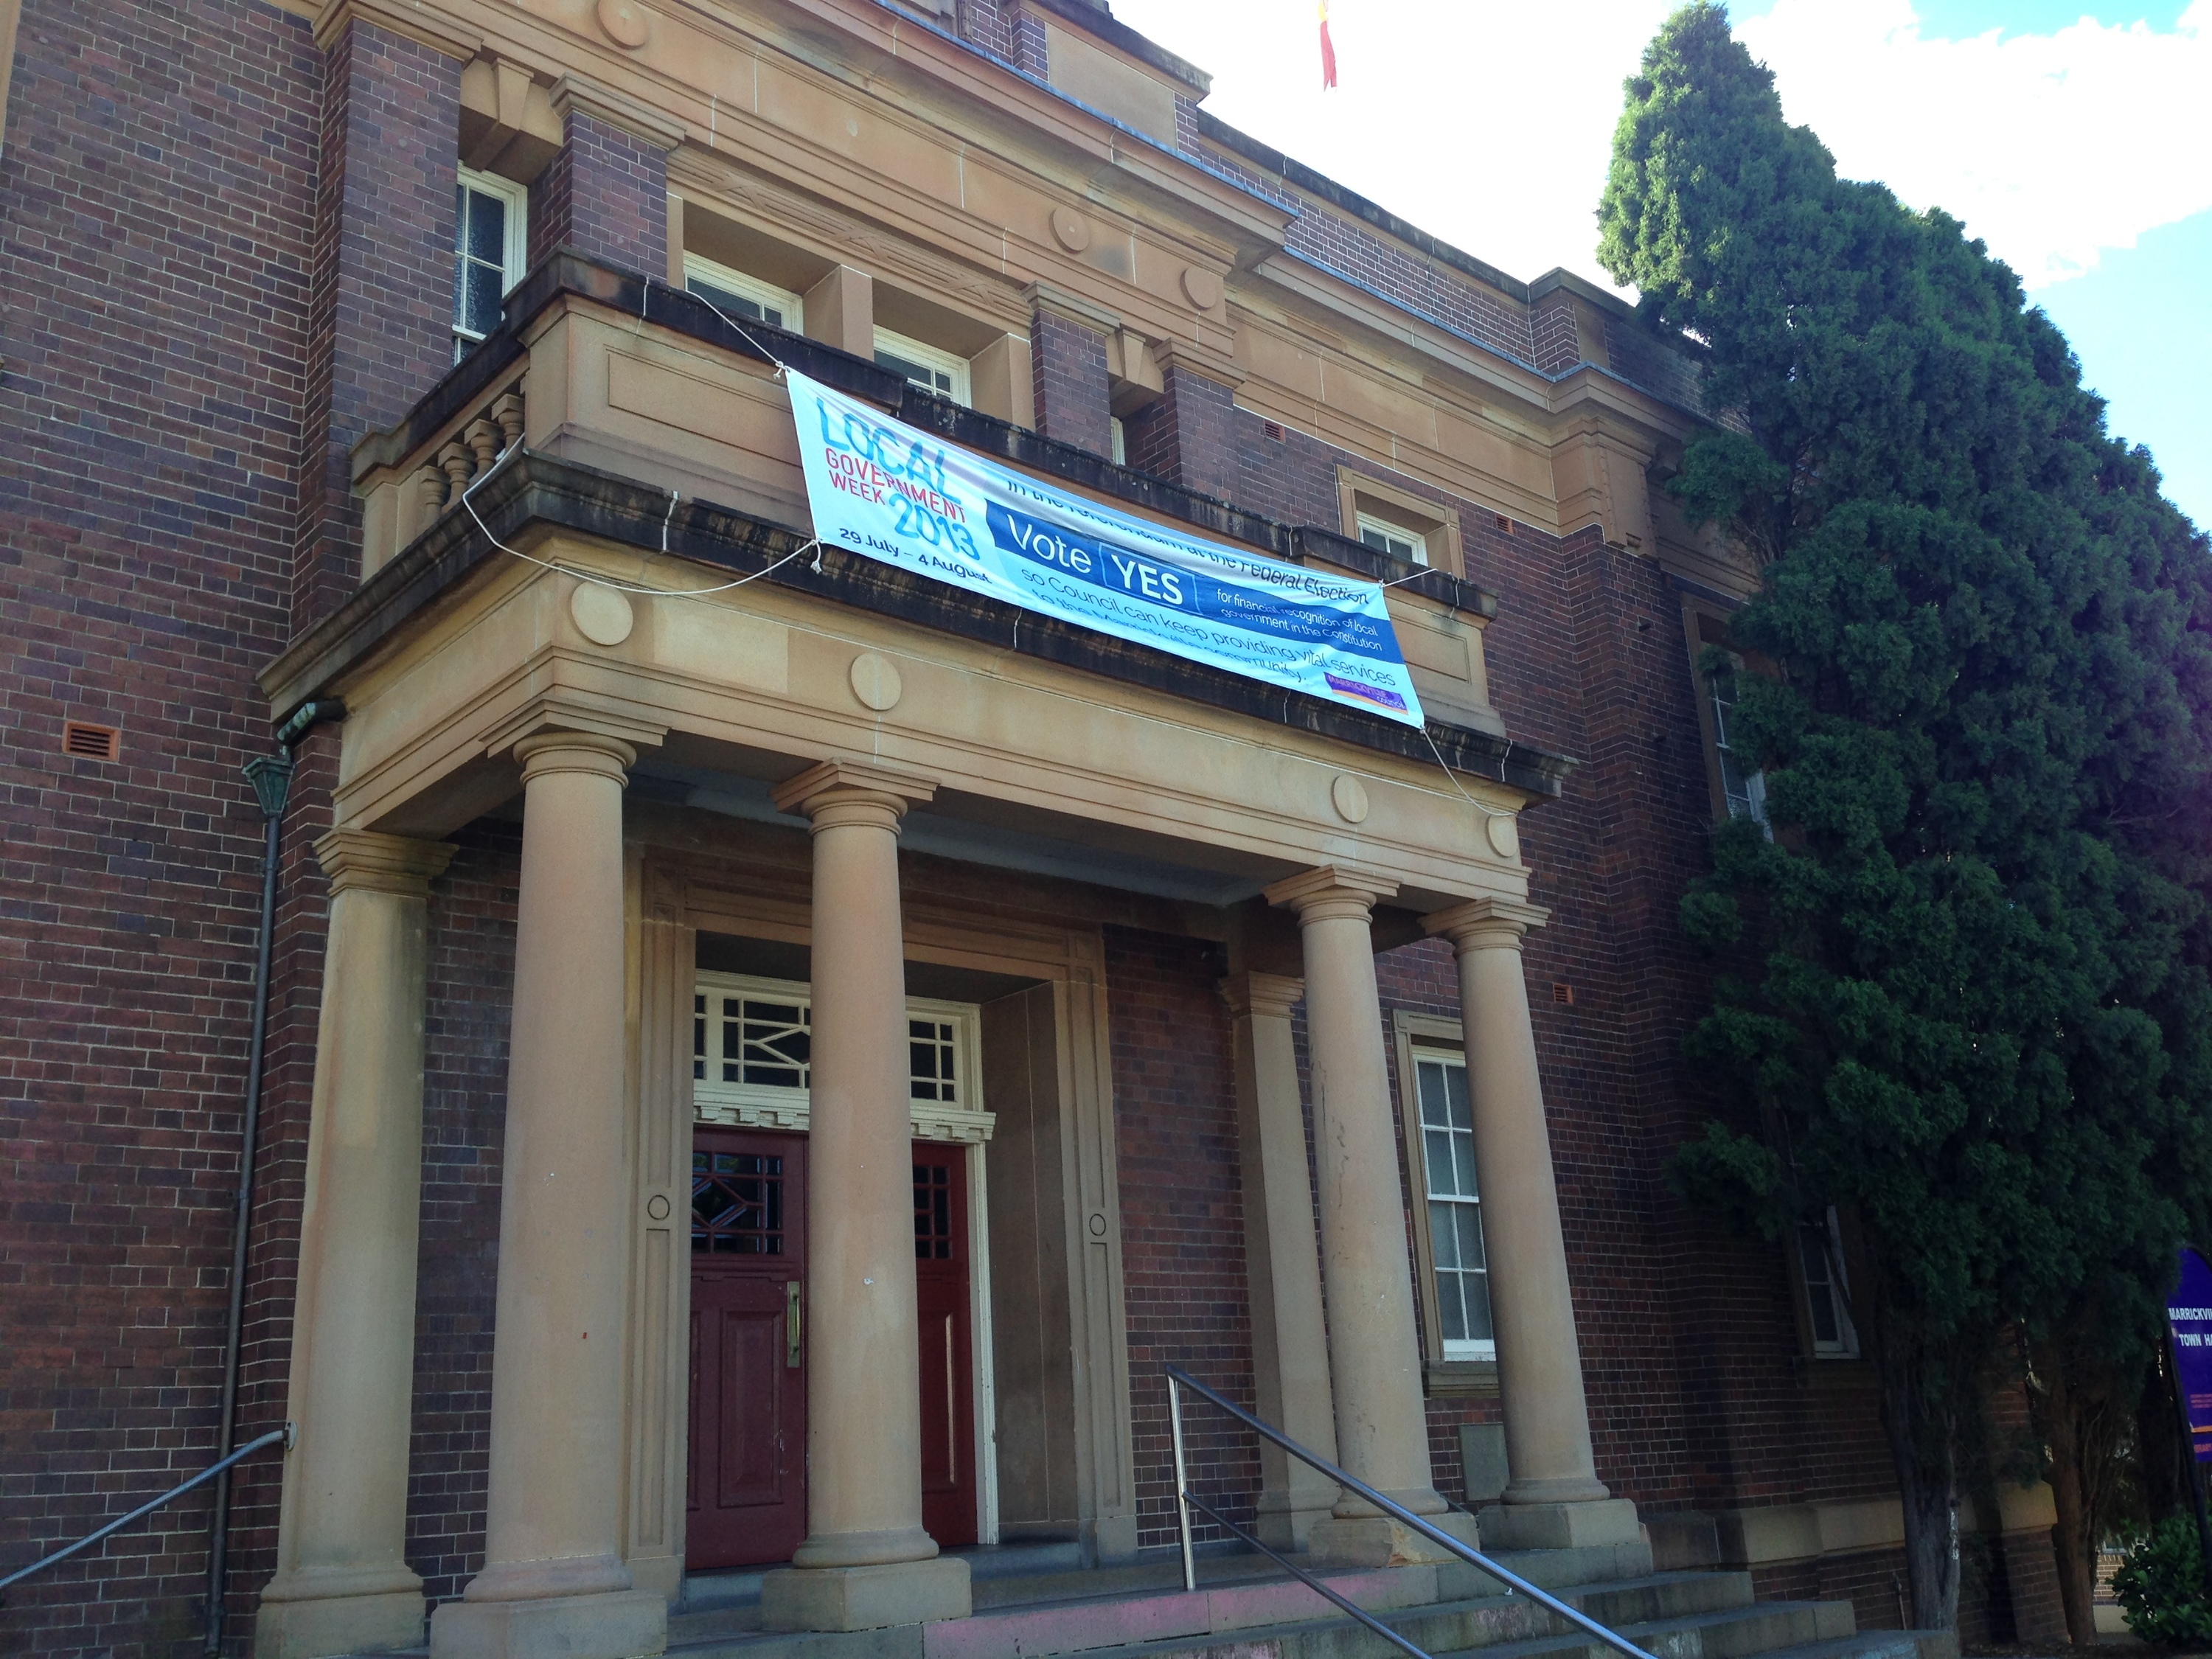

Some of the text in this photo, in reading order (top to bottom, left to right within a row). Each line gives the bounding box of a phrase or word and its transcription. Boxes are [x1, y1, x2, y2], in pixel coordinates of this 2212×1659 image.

[816, 397, 961, 504] LOCAL
[825, 448, 966, 523] GOVERNMENT
[829, 470, 886, 506] WEEK
[888, 493, 981, 561] 2013
[1032, 490, 1064, 509] the
[1207, 550, 1237, 568] the
[1241, 560, 1301, 591] Federal
[1304, 577, 1370, 605] Election
[839, 528, 862, 544] 29
[866, 535, 899, 557] July
[918, 554, 929, 566] 4
[932, 556, 992, 584] August
[1006, 514, 1183, 605] Vote YES
[1021, 568, 1396, 686] so Council can keep providing vital services
[1032, 588, 1054, 605] to
[1056, 597, 1092, 616] the
[1217, 588, 1378, 636] for financial recognition of local
[1220, 608, 1290, 631] government
[1291, 622, 1301, 633] in
[1302, 625, 1321, 636] the
[2168, 1307, 2212, 1320] MARRICKVI
[2179, 1334, 2212, 1346] TOWN H
